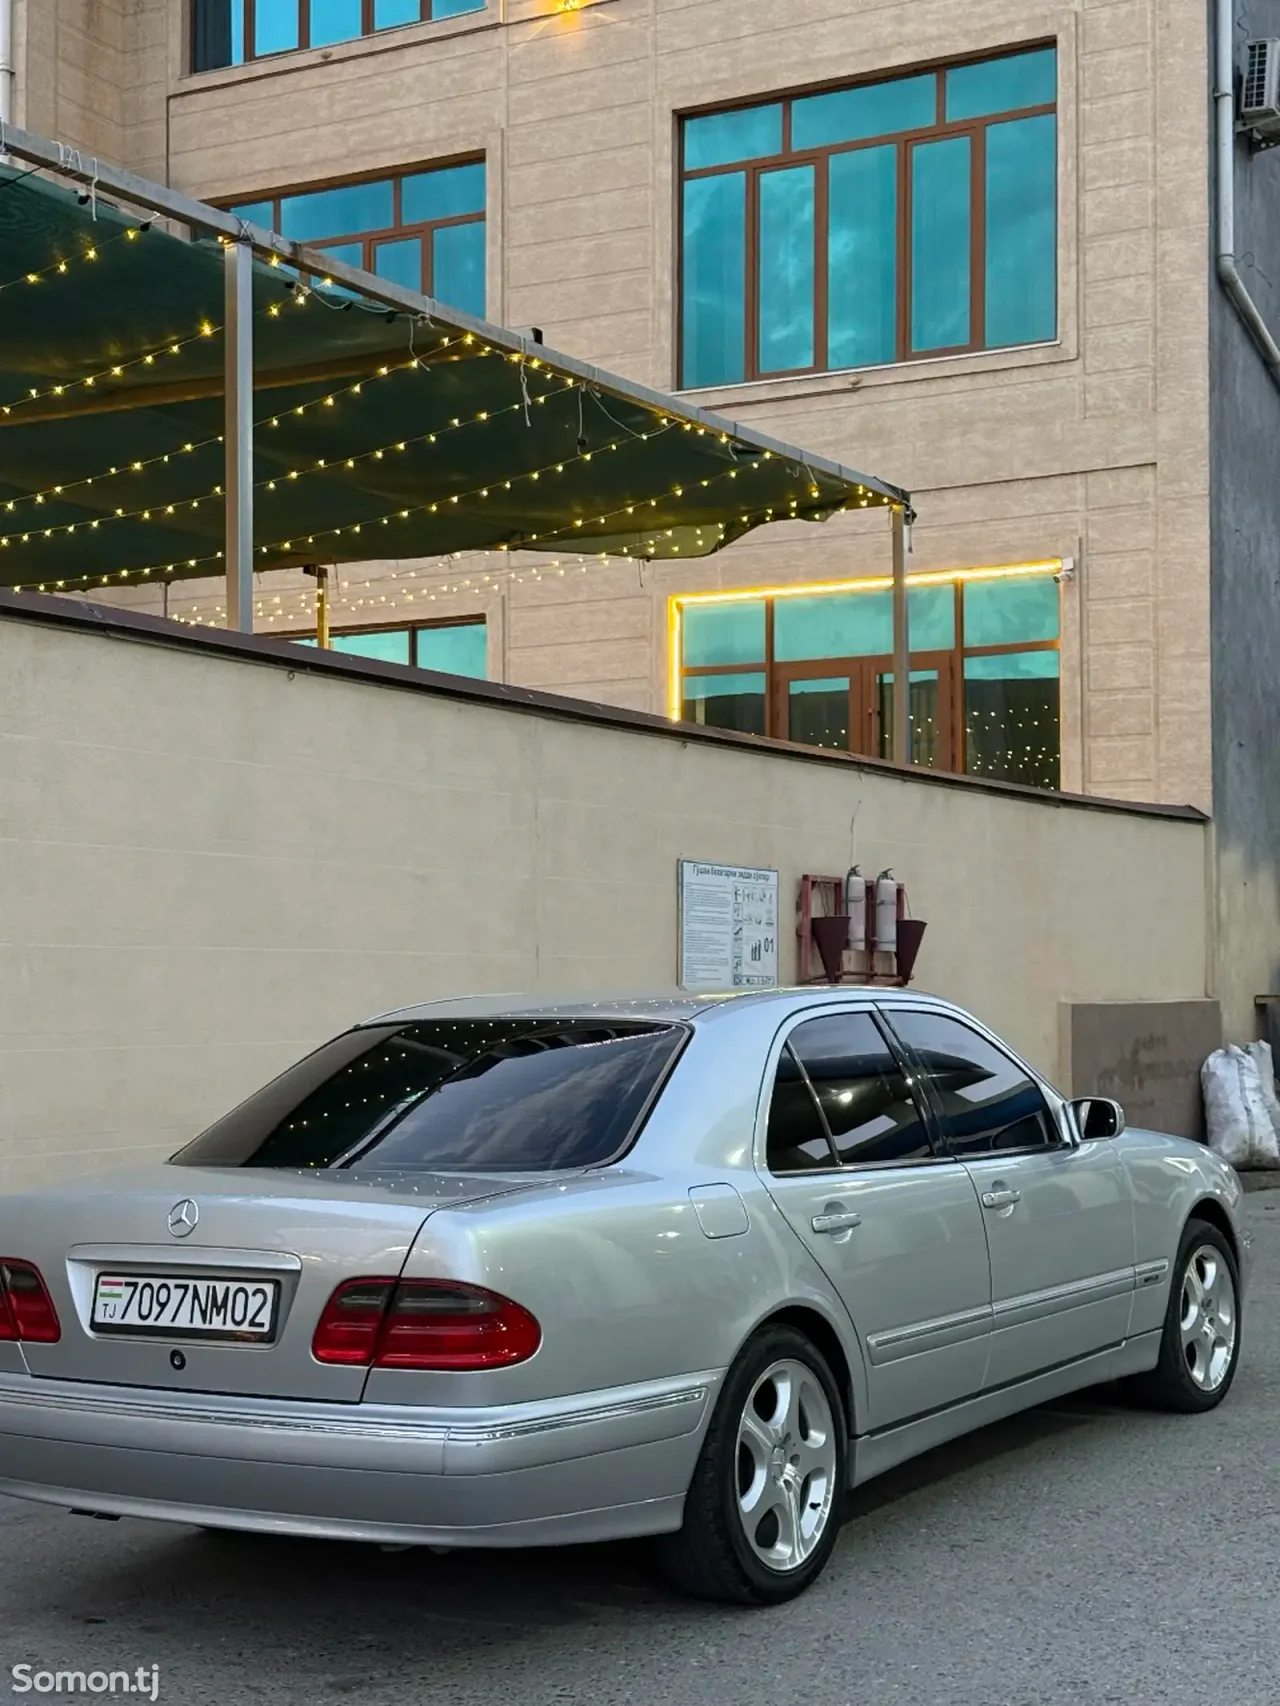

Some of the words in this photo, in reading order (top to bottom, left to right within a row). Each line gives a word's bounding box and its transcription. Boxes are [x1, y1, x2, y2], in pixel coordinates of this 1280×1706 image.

[763, 937, 774, 953] 01
[102, 1303, 117, 1319] TJ
[120, 1281, 268, 1328] 7097NM02
